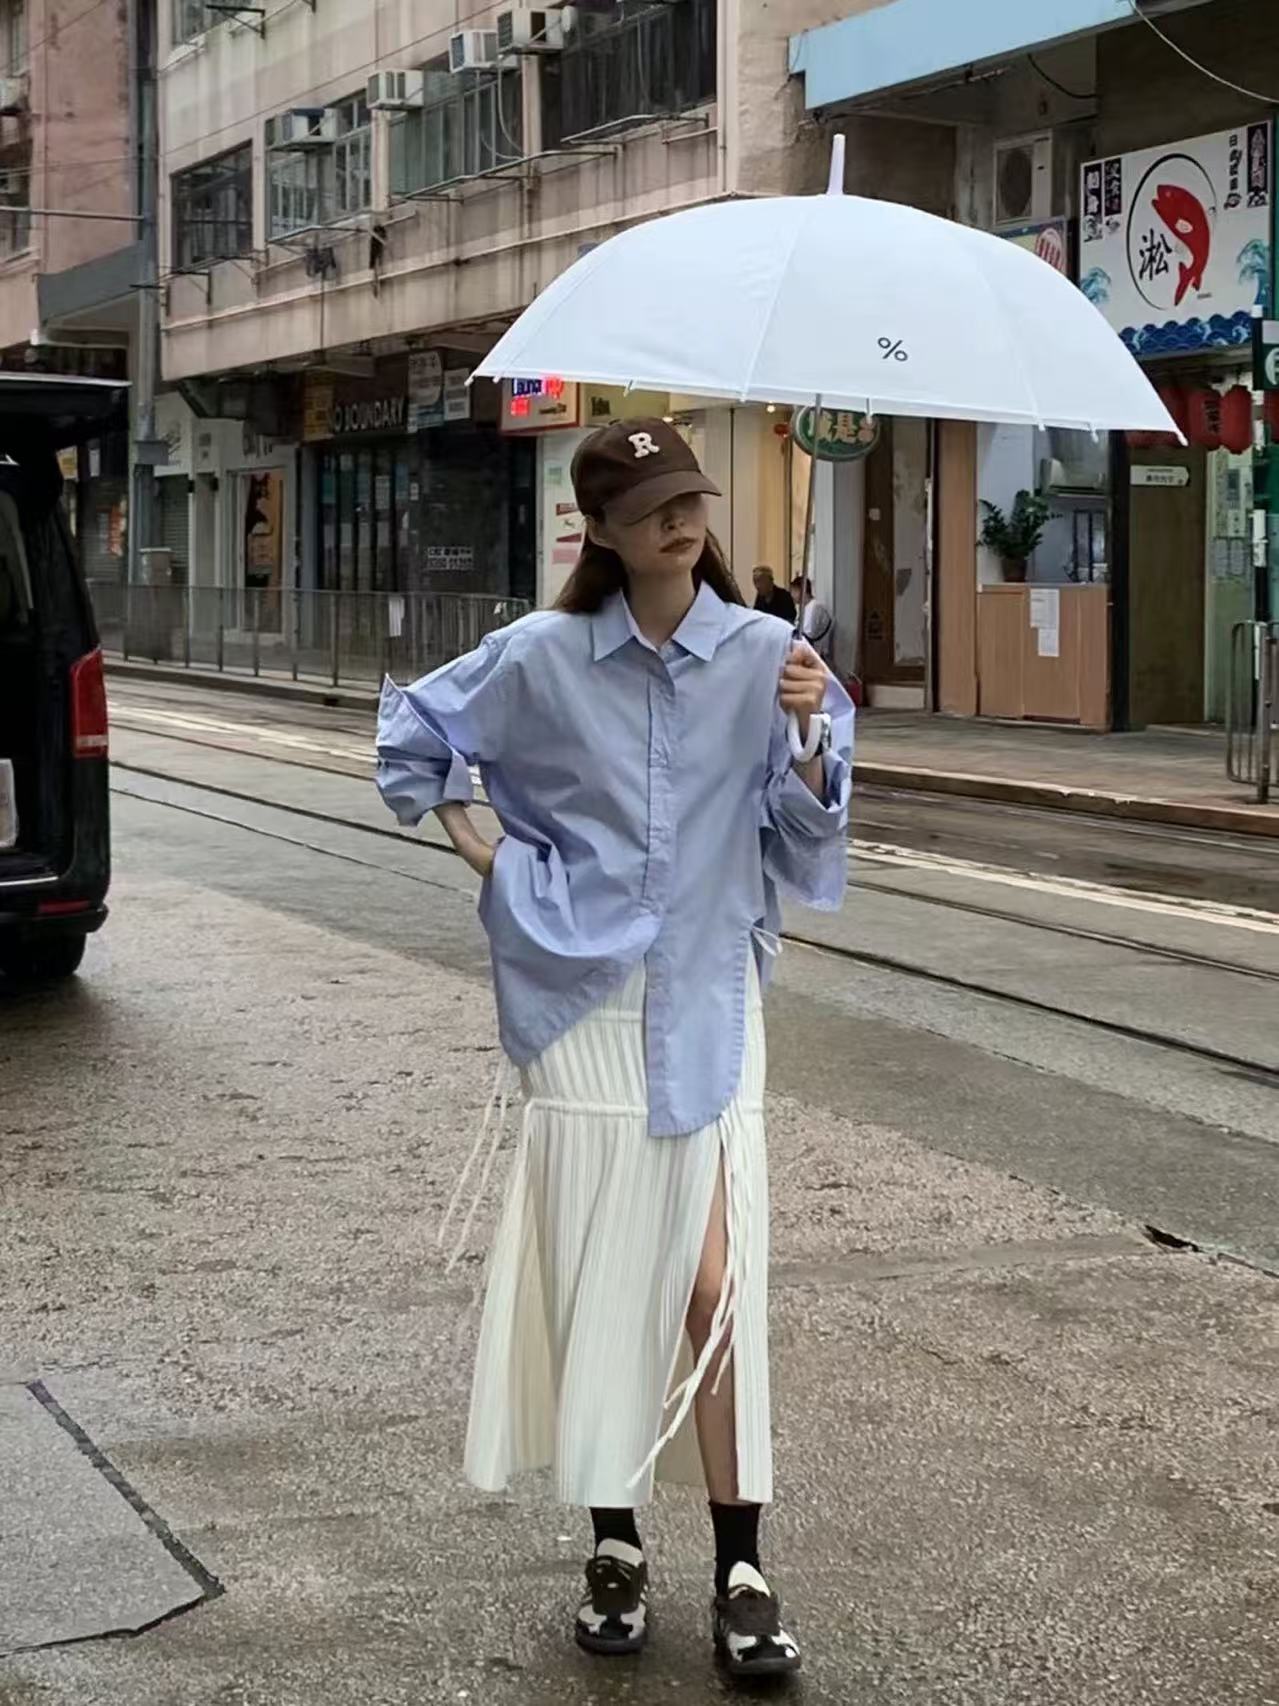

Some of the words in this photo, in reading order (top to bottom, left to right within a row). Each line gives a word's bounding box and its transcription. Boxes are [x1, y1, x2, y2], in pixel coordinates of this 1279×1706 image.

[1138, 228, 1173, 281] 淞
[877, 337, 908, 362] %
[628, 432, 660, 458] R
